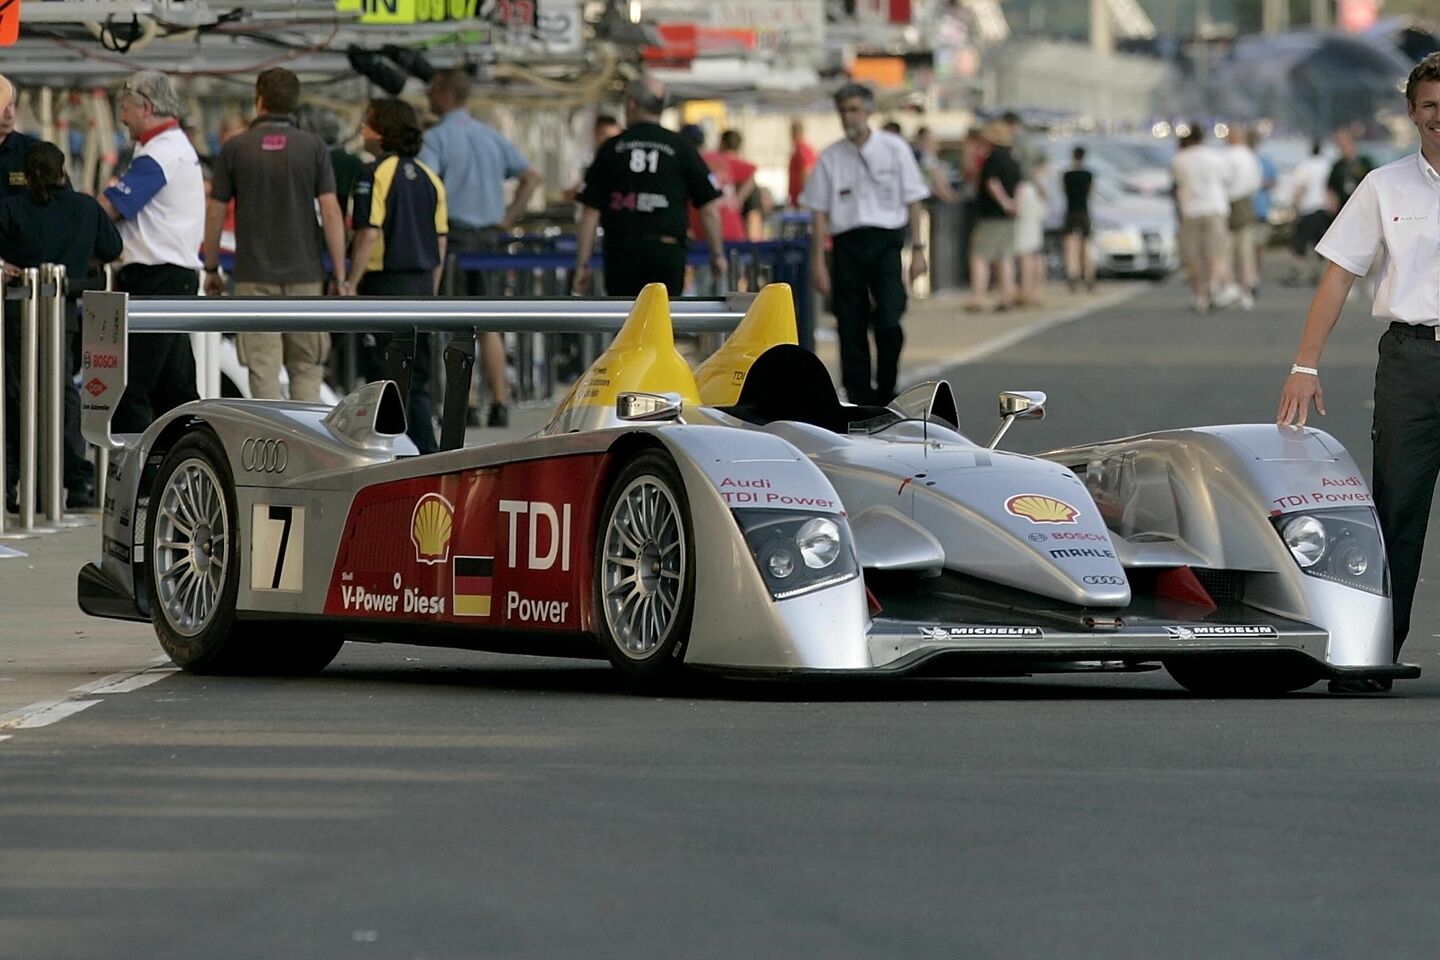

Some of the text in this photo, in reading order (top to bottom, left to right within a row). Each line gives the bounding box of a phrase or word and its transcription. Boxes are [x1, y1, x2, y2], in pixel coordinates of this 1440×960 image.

[629, 149, 659, 173] 81
[93, 354, 118, 369] BOSCH
[720, 477, 771, 489] Audi
[1321, 476, 1361, 487] Audi
[721, 492, 835, 508] TDI Power
[1273, 492, 1371, 509] TDI Power
[499, 500, 571, 571] TDI
[1051, 532, 1108, 542] BOSCH
[268, 506, 293, 589] 7
[1049, 548, 1116, 559] MAHLE
[341, 585, 399, 613] V-Power
[507, 591, 568, 623] Power
[951, 627, 1038, 635] MICHELIN
[1193, 626, 1272, 634] MICHELIN
